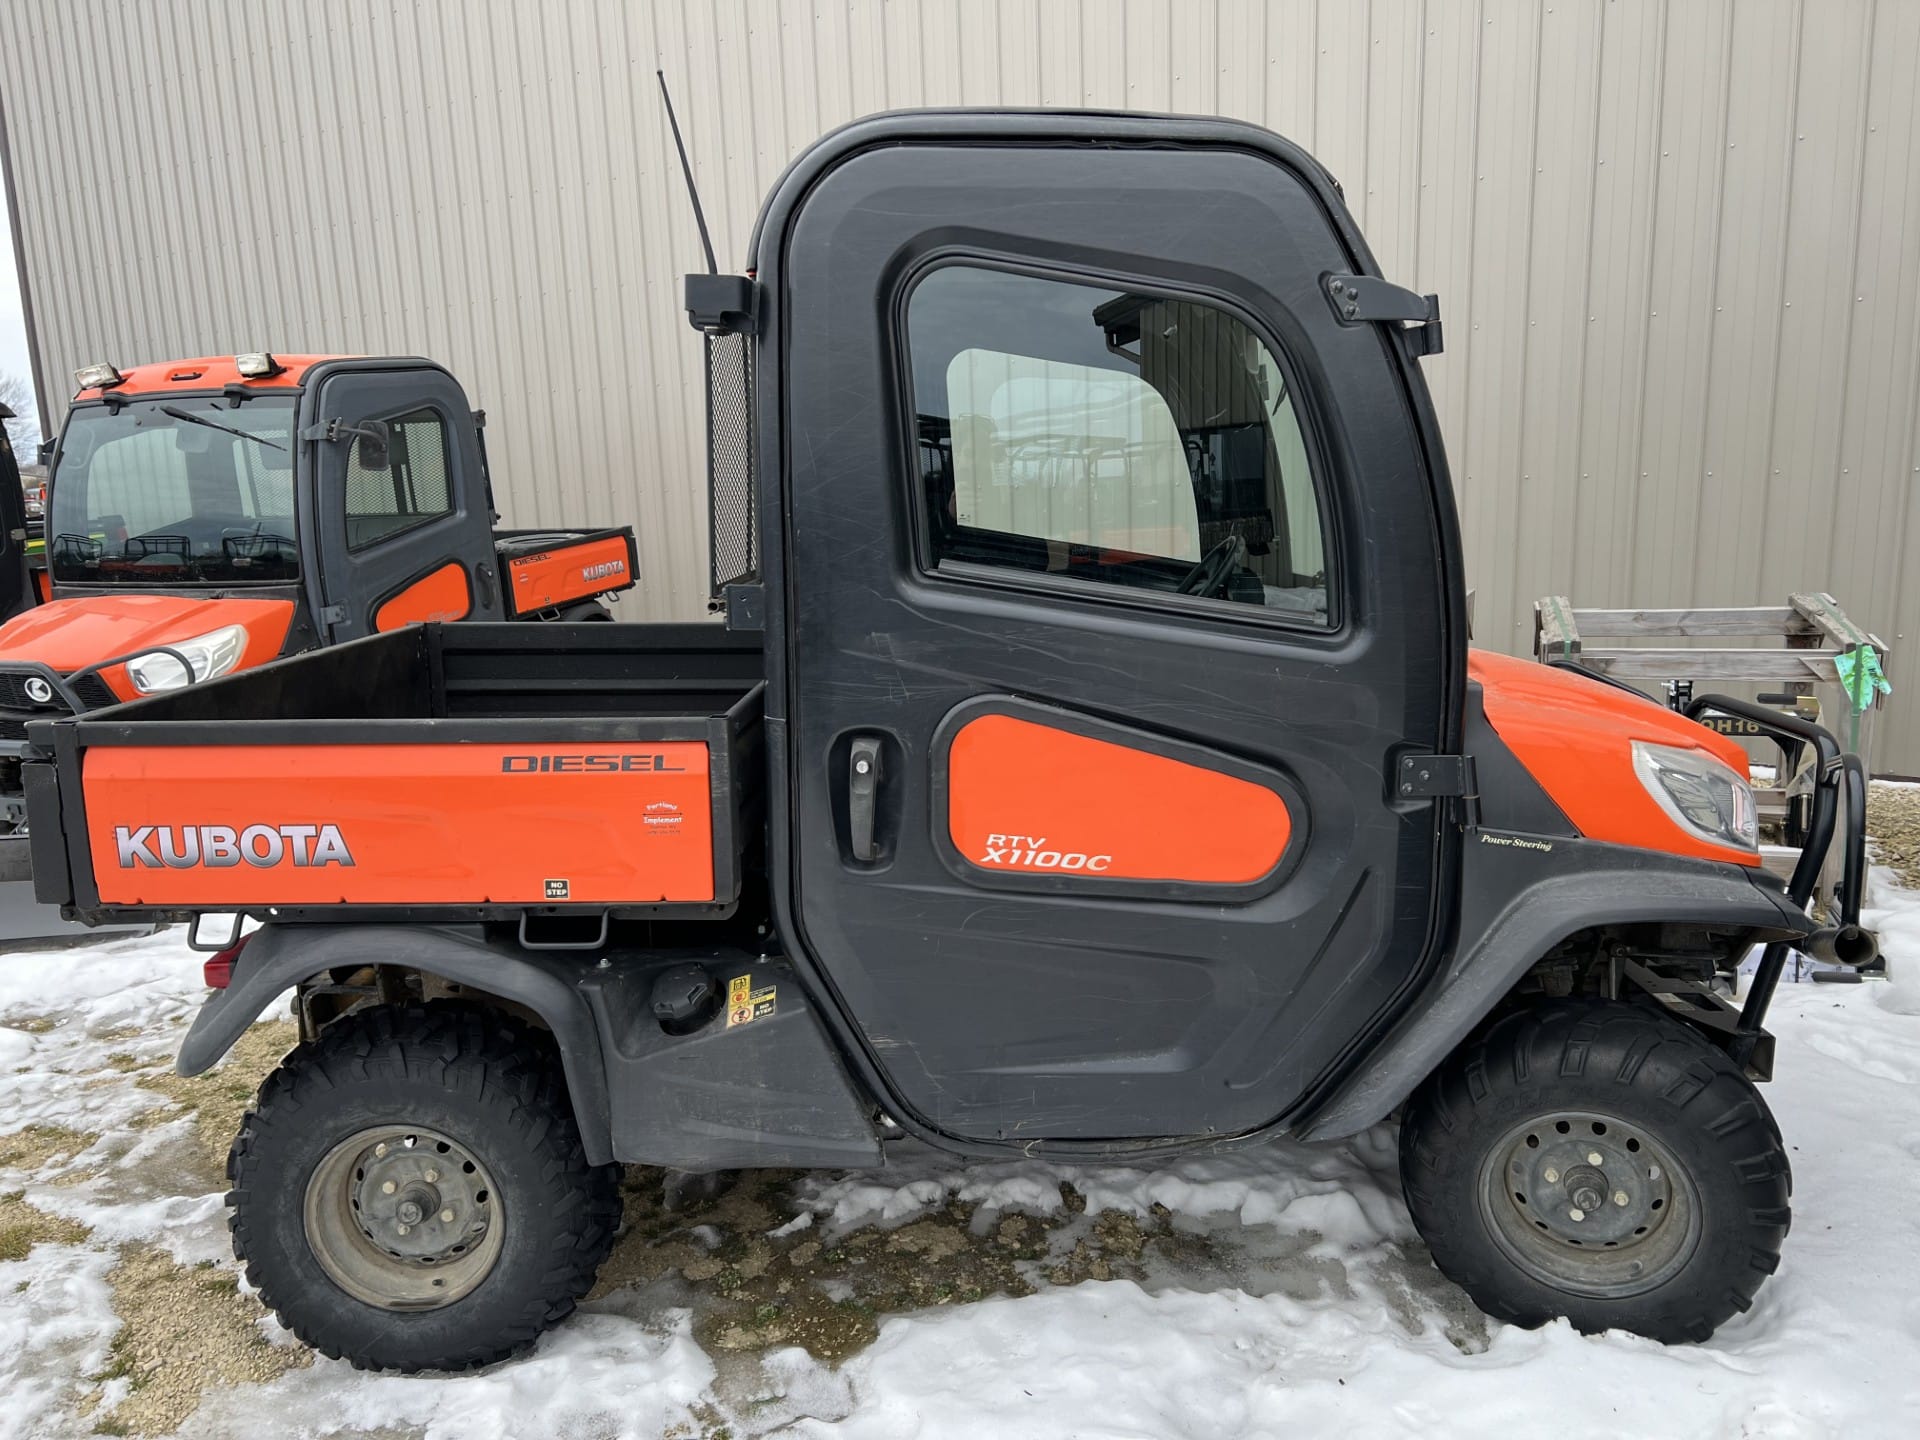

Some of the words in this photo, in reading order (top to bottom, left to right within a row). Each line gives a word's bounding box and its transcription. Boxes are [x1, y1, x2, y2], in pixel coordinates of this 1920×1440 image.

[582, 560, 625, 582] KUBOTA
[502, 755, 686, 773] DIESEL
[115, 824, 357, 869] KUBOTA
[986, 833, 1047, 849] RTV
[1481, 834, 1512, 846] Power
[1512, 838, 1553, 852] Steering
[980, 847, 1113, 872] X1100C
